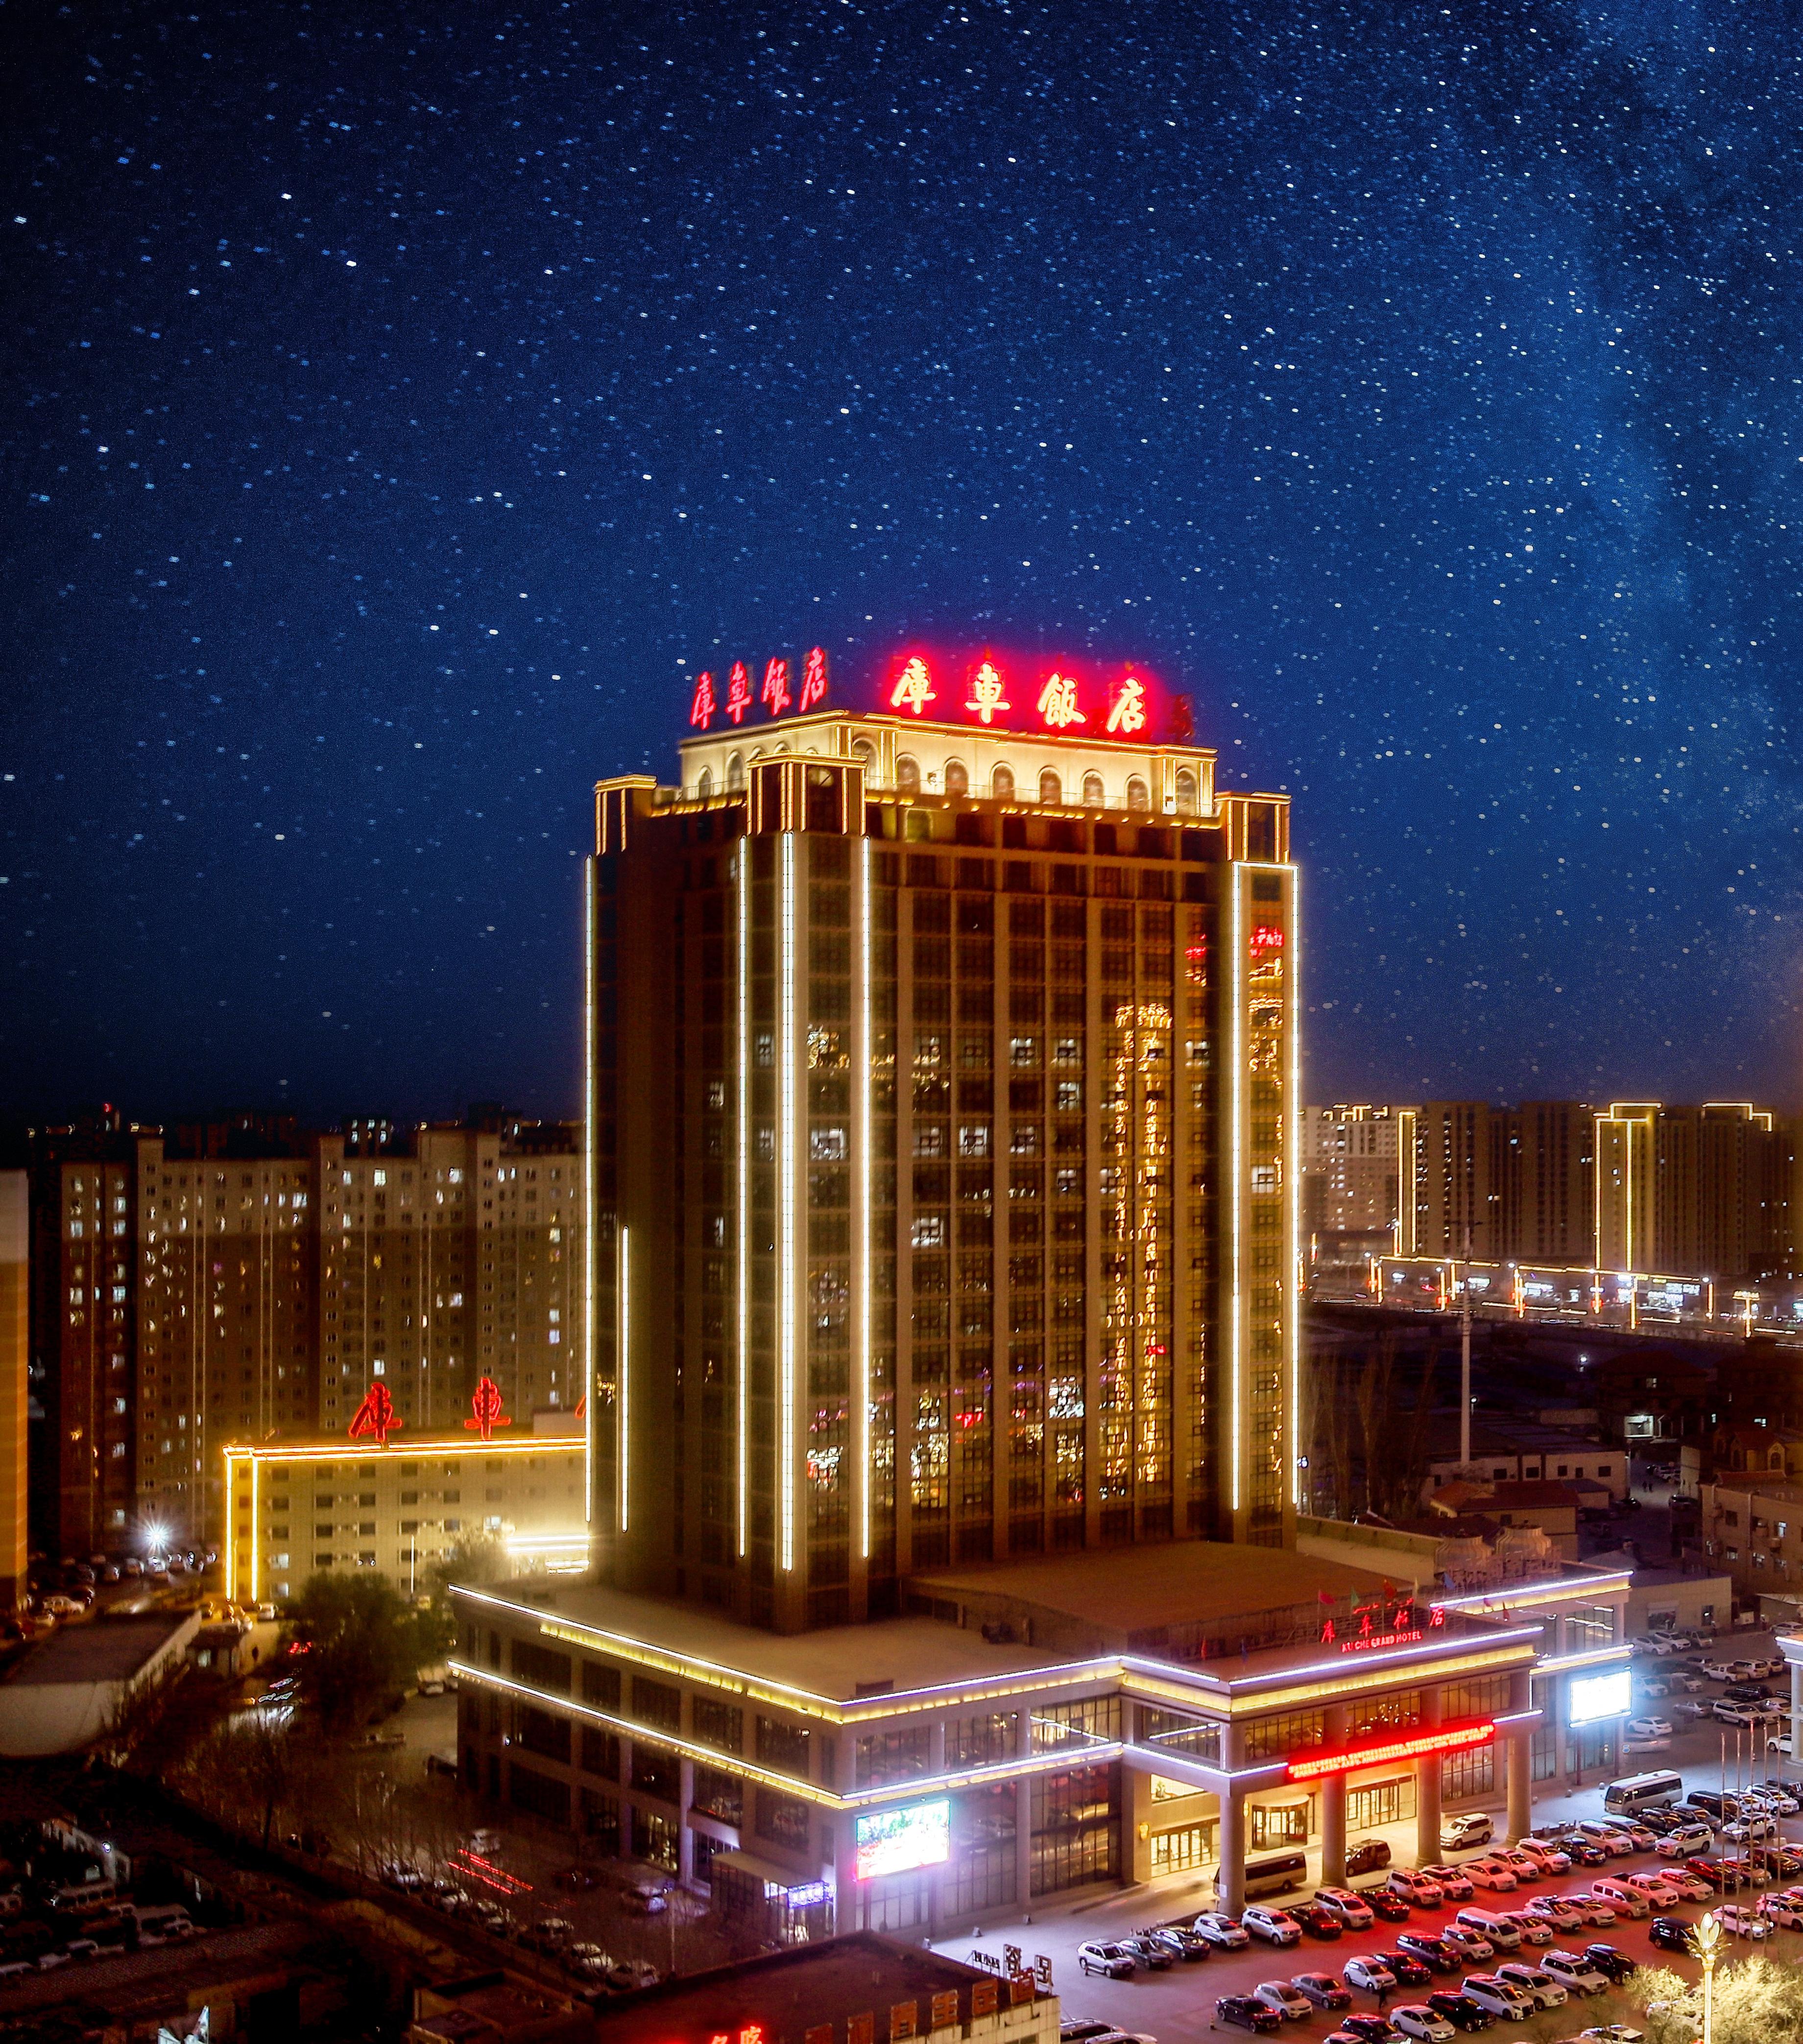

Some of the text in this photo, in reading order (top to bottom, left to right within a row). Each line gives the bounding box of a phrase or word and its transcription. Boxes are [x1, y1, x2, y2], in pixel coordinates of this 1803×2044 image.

[1354, 1639, 1370, 1650] CHE
[1370, 1634, 1395, 1649] GRAND
[1396, 1630, 1422, 1644] HOTEL
